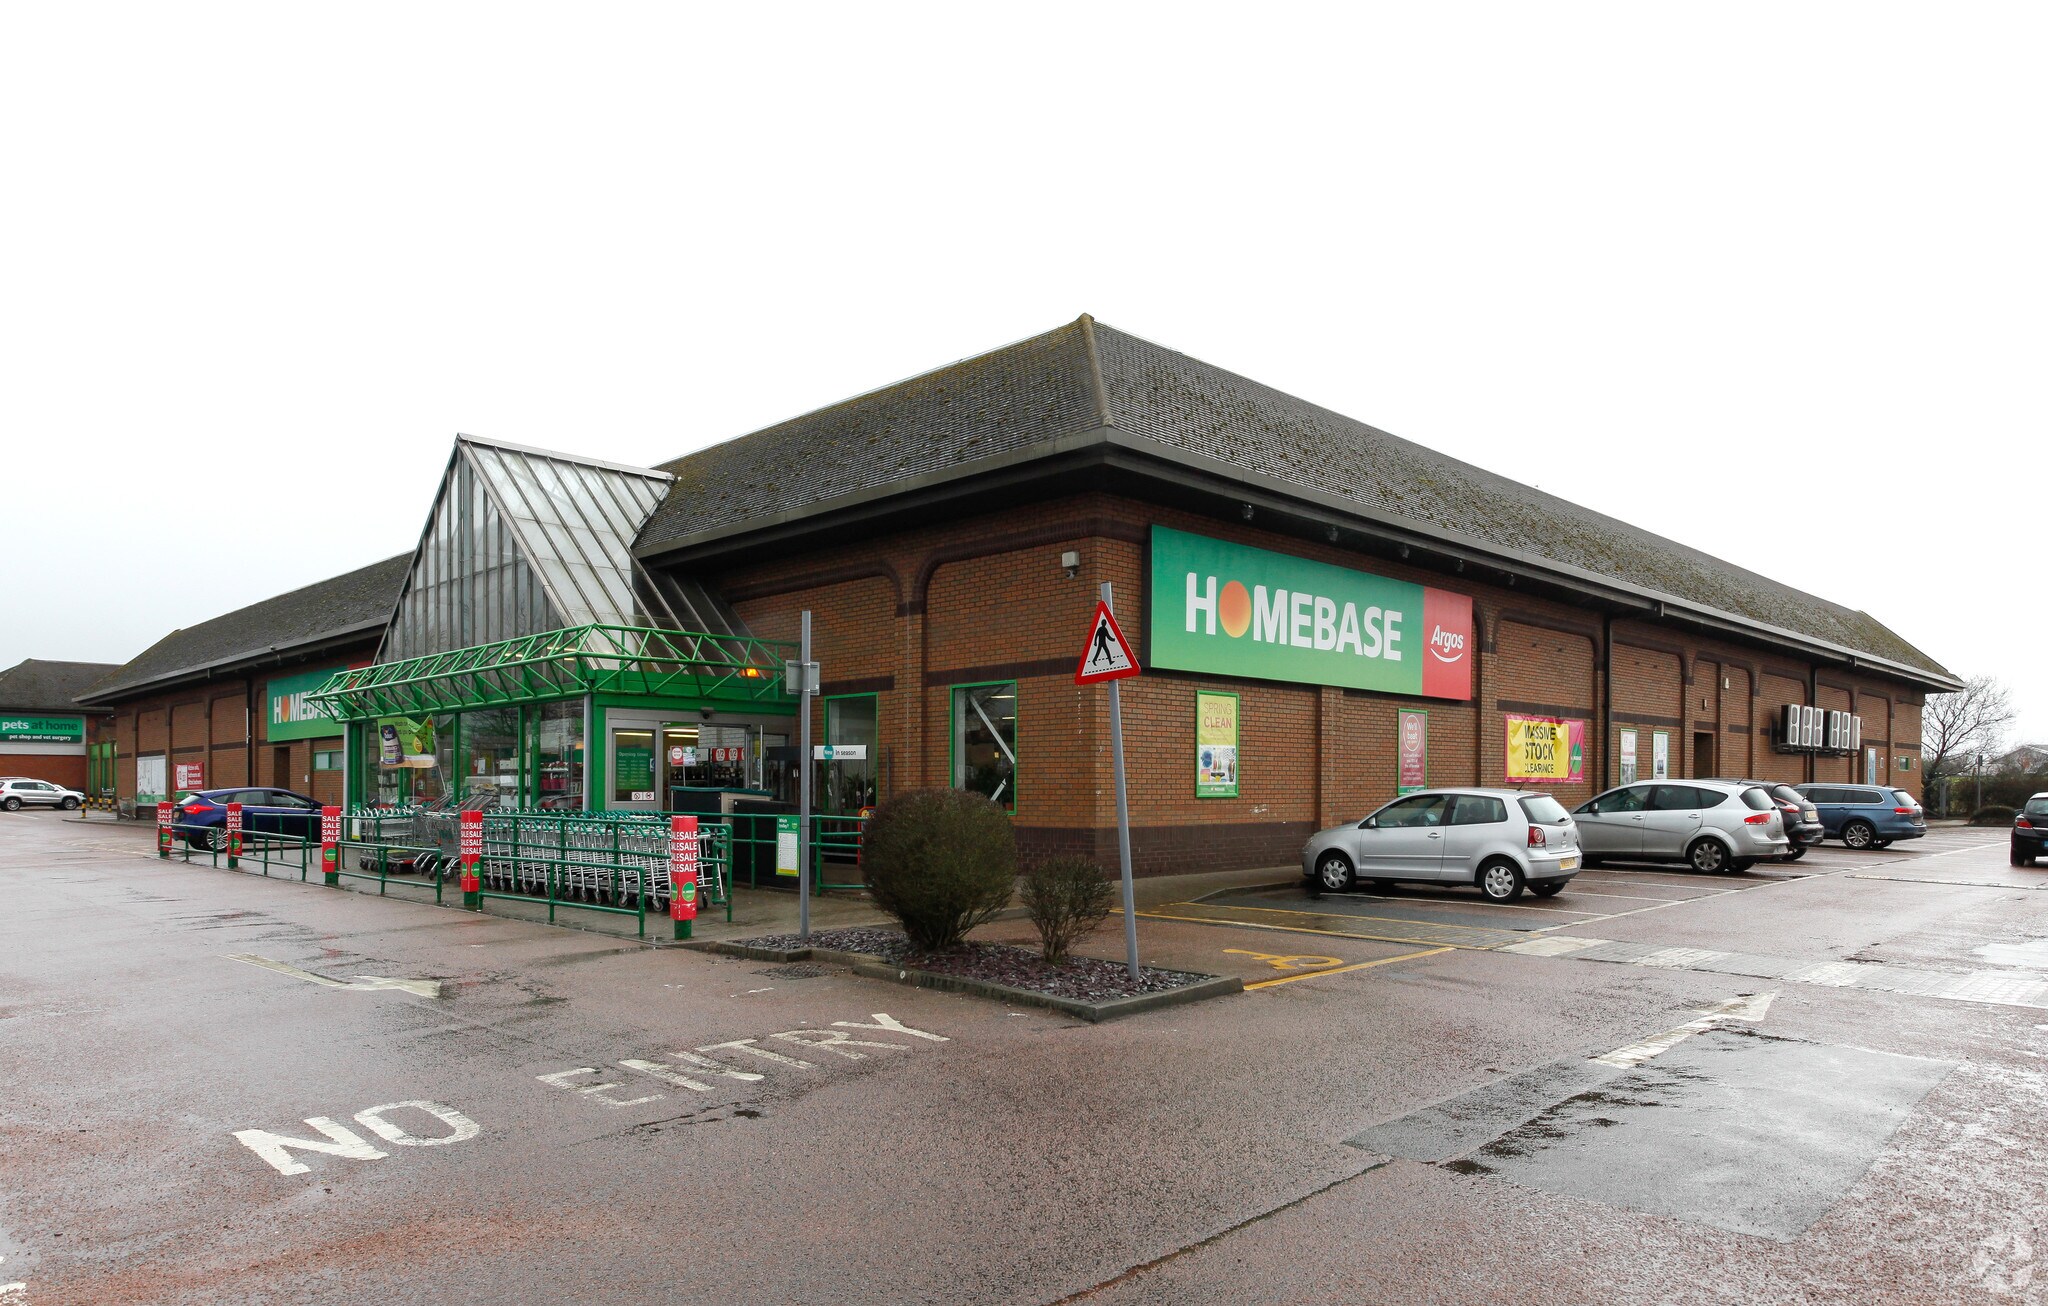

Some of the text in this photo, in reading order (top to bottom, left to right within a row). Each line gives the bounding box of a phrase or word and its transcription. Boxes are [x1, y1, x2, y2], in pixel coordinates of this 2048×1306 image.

[1186, 572, 1402, 661] HOMEBASE
[1431, 624, 1464, 653] Argos
[1203, 702, 1232, 715] SPRING
[2, 720, 78, 731] pets at home
[1203, 717, 1232, 729] CLEAN
[1525, 742, 1555, 760] STOCK
[680, 831, 697, 840] SALE
[680, 842, 697, 850] SALE
[680, 853, 697, 861] SALE
[680, 863, 697, 872] SALE
[231, 1013, 950, 1176] NO ENTRY
